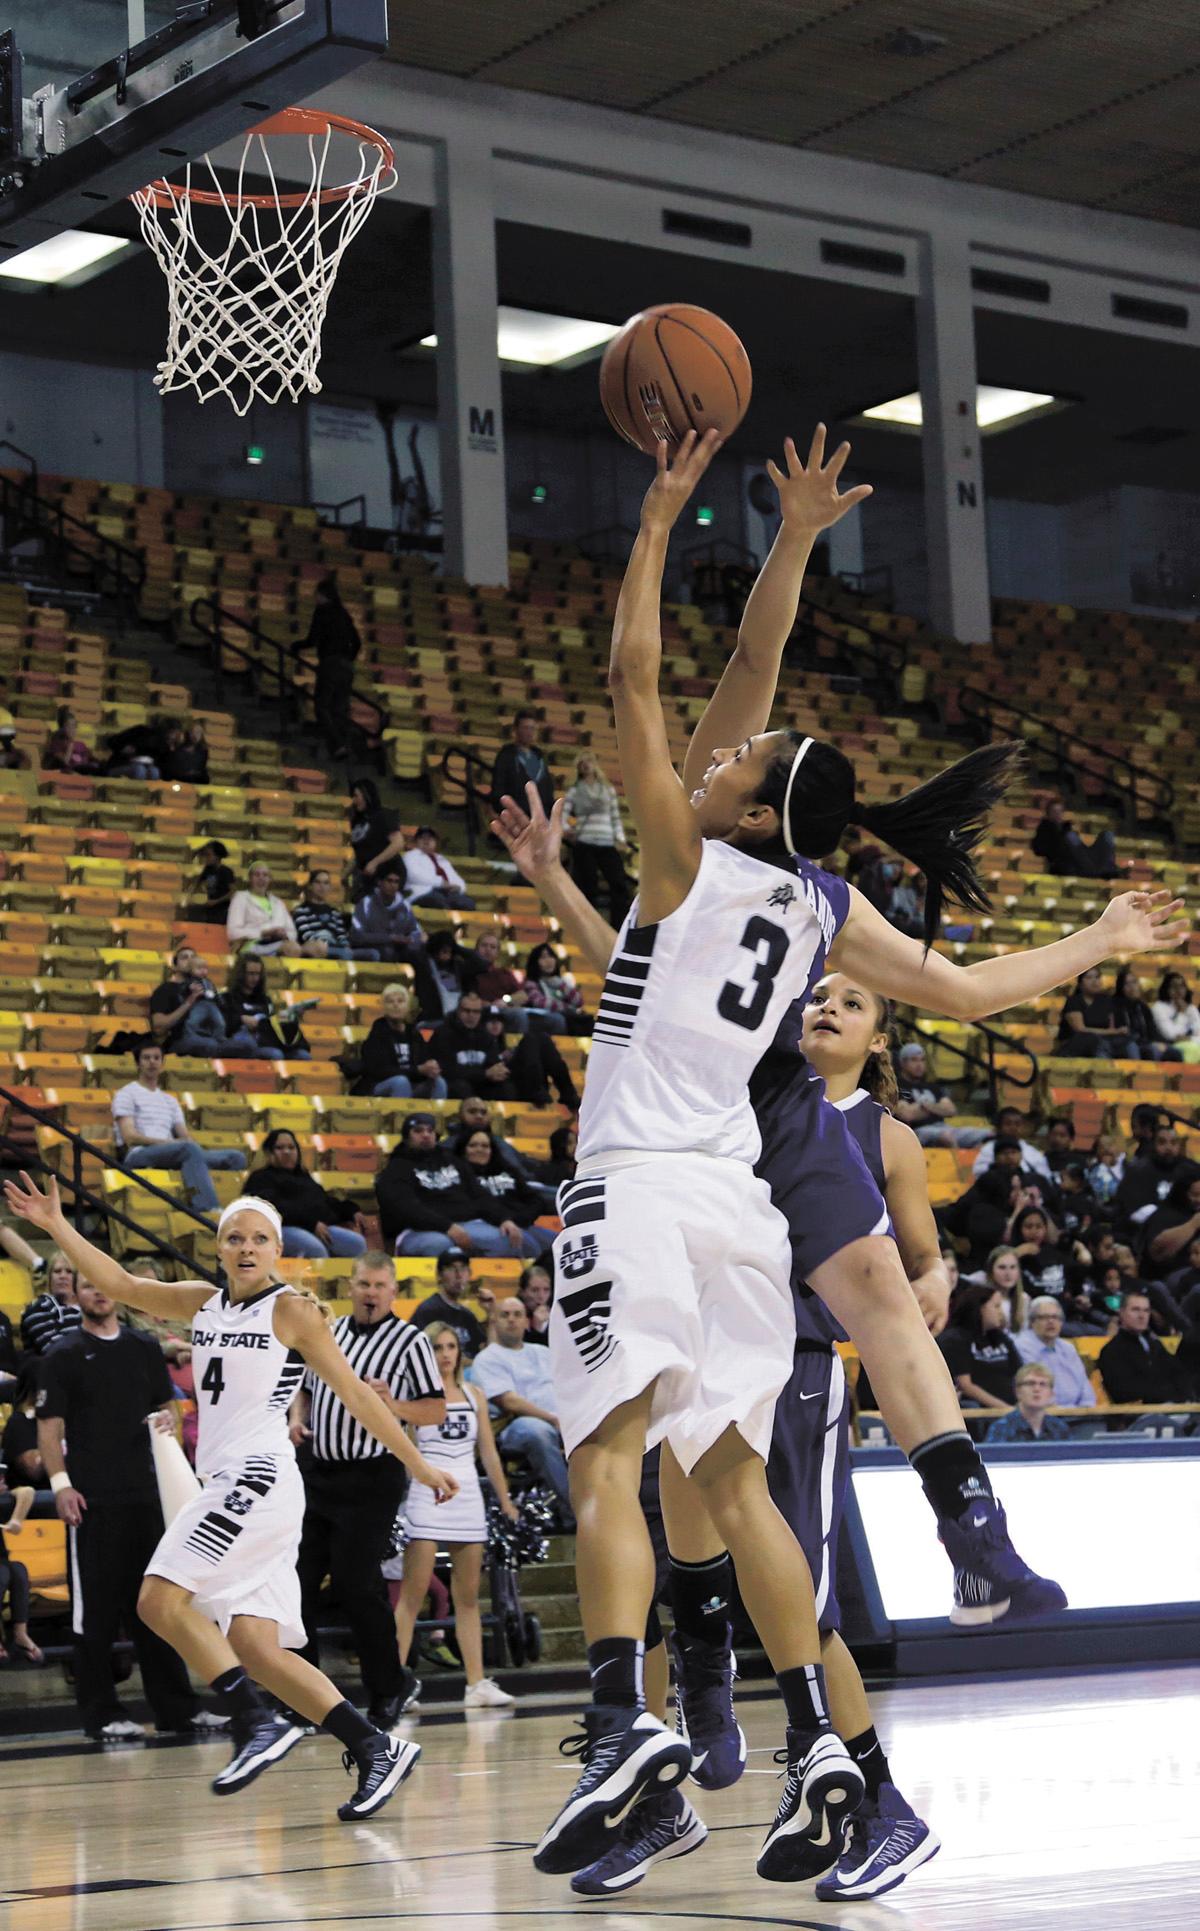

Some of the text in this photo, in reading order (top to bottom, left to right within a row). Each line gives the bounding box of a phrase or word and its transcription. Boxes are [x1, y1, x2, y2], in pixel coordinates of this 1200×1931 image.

[469, 406, 494, 437] M
[958, 481, 977, 508] N
[716, 915, 790, 1031] 3
[219, 1332, 271, 1350] STATE
[201, 1357, 225, 1406] 4
